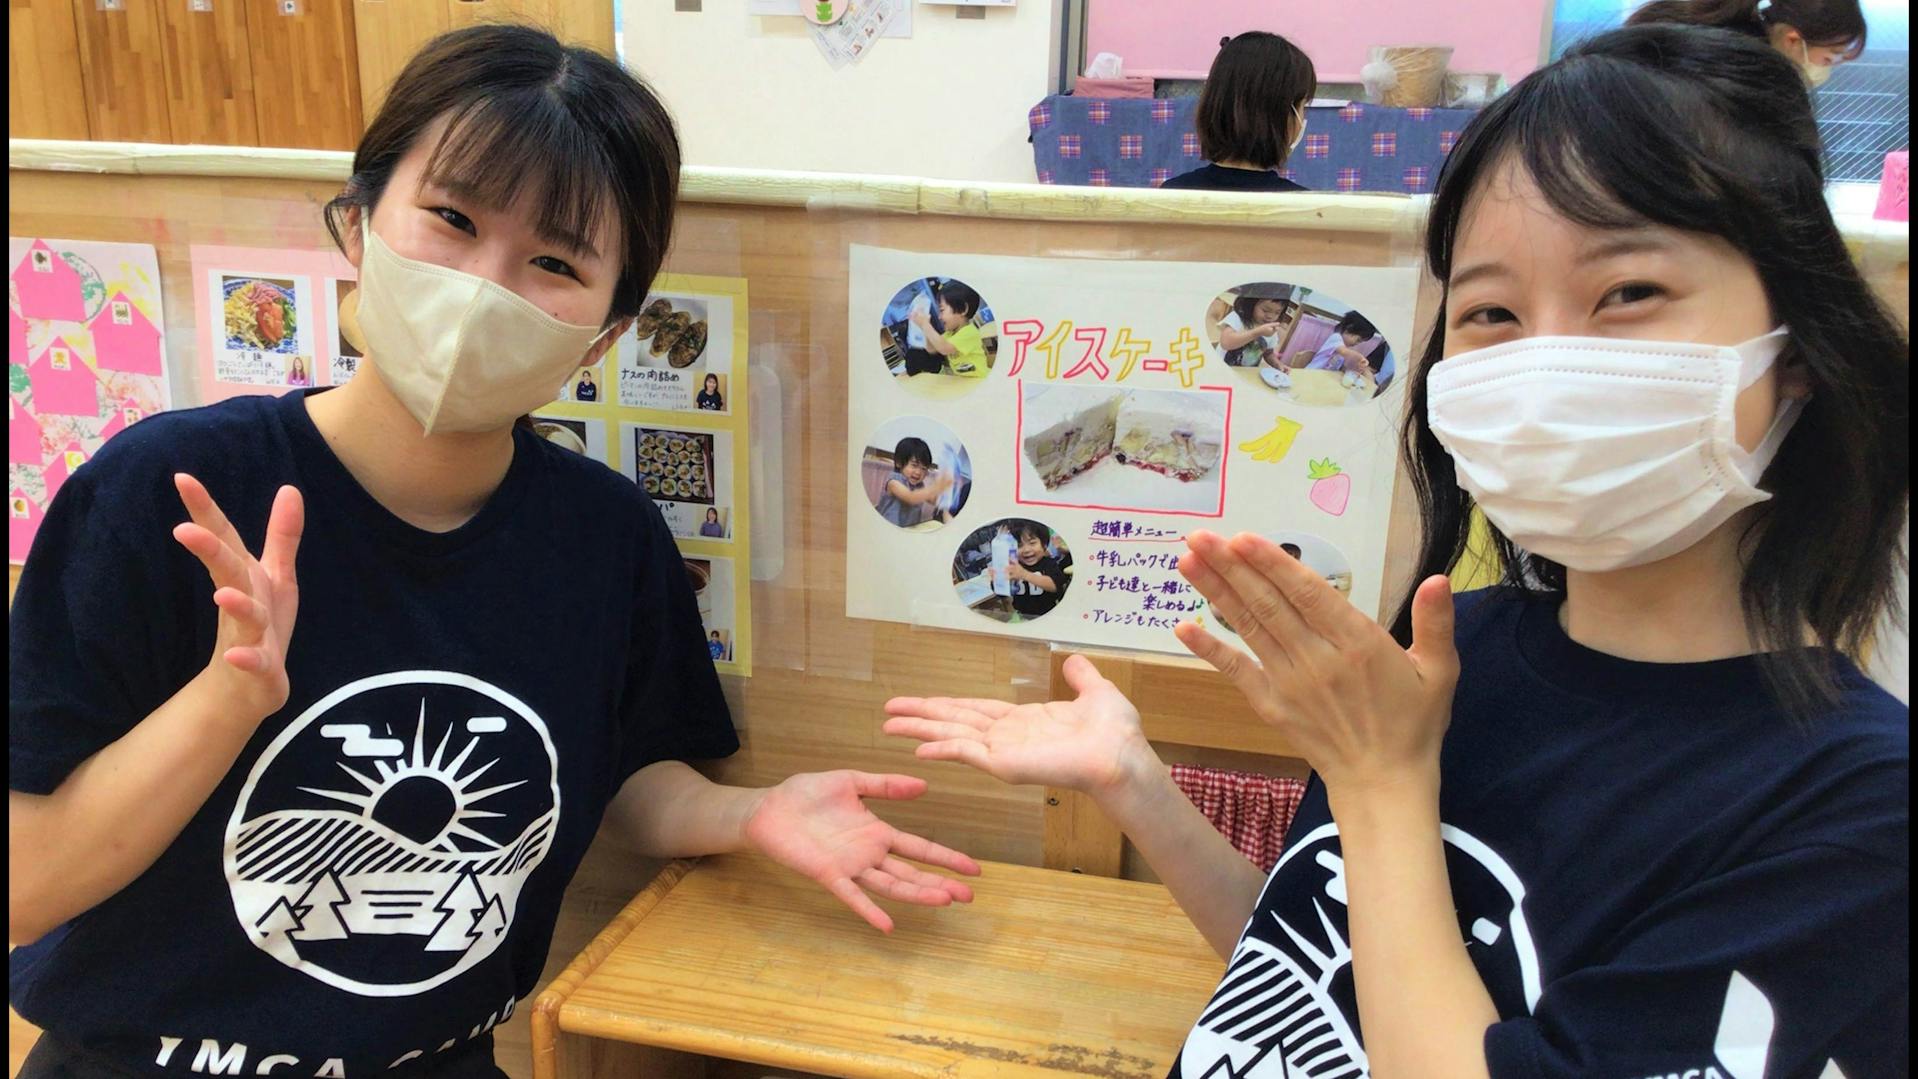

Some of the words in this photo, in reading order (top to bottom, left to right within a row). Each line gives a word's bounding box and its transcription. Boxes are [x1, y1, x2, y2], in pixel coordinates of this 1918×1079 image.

[1003, 319, 1205, 388] アイスケーキ
[621, 368, 680, 382] ナスの肉詰め
[1090, 520, 1177, 538] 超簡単メニュー
[1096, 575, 1192, 595] 子ども達と一緒に
